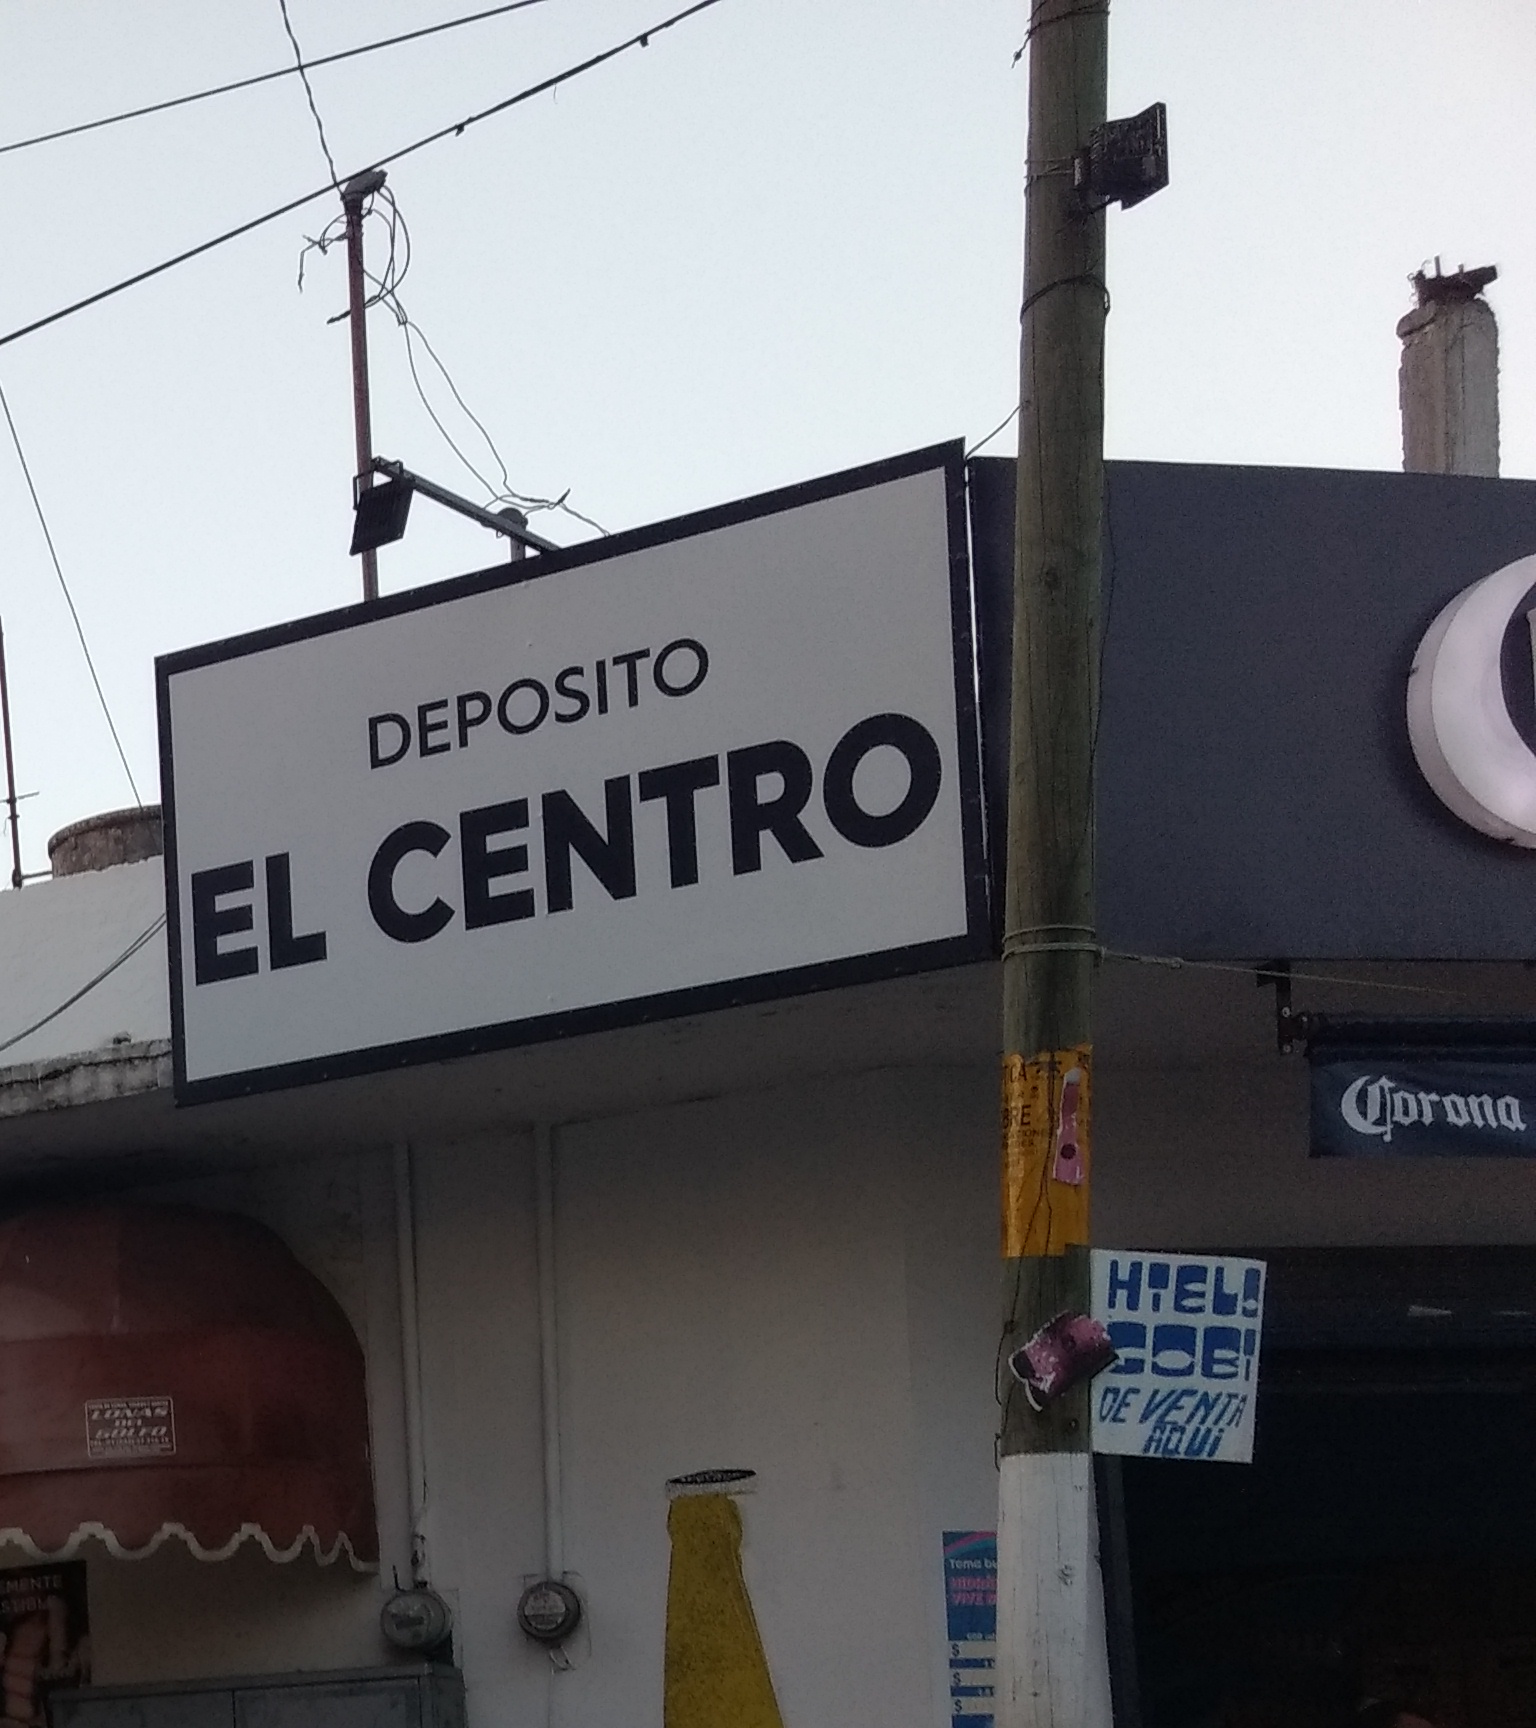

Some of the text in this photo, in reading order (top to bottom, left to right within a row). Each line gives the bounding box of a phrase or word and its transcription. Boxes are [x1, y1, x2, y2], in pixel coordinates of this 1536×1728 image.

[368, 637, 710, 770] DEPOSITO
[190, 712, 942, 986] EL CENTRO
[1340, 1075, 1527, 1143] Corona
[1099, 1386, 1248, 1428] DE VENTA
